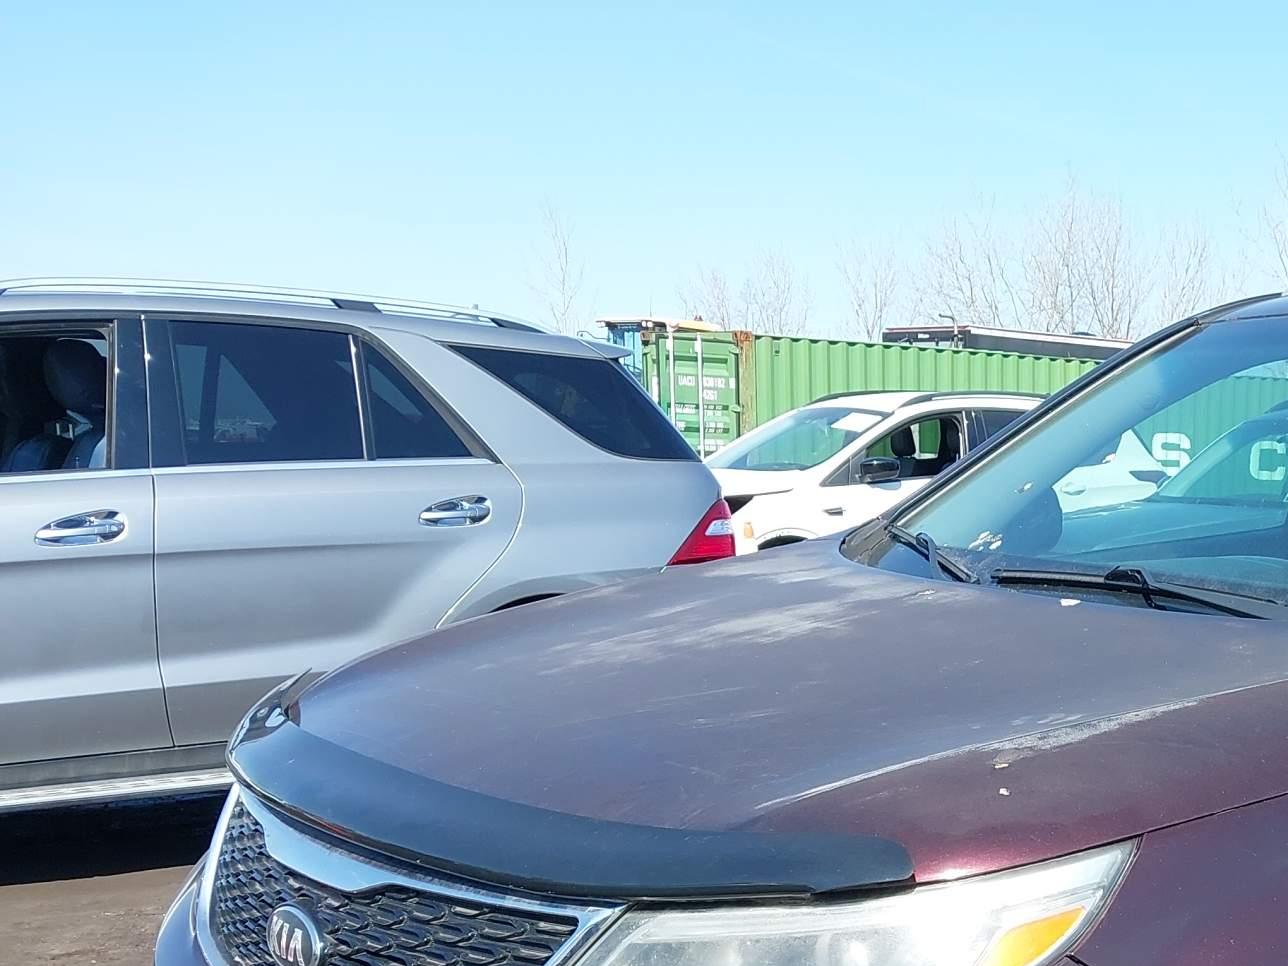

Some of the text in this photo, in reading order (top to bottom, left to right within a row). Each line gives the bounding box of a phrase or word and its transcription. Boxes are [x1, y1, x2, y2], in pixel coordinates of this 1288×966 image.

[1151, 432, 1287, 481] S C
[269, 915, 305, 966] KIA
